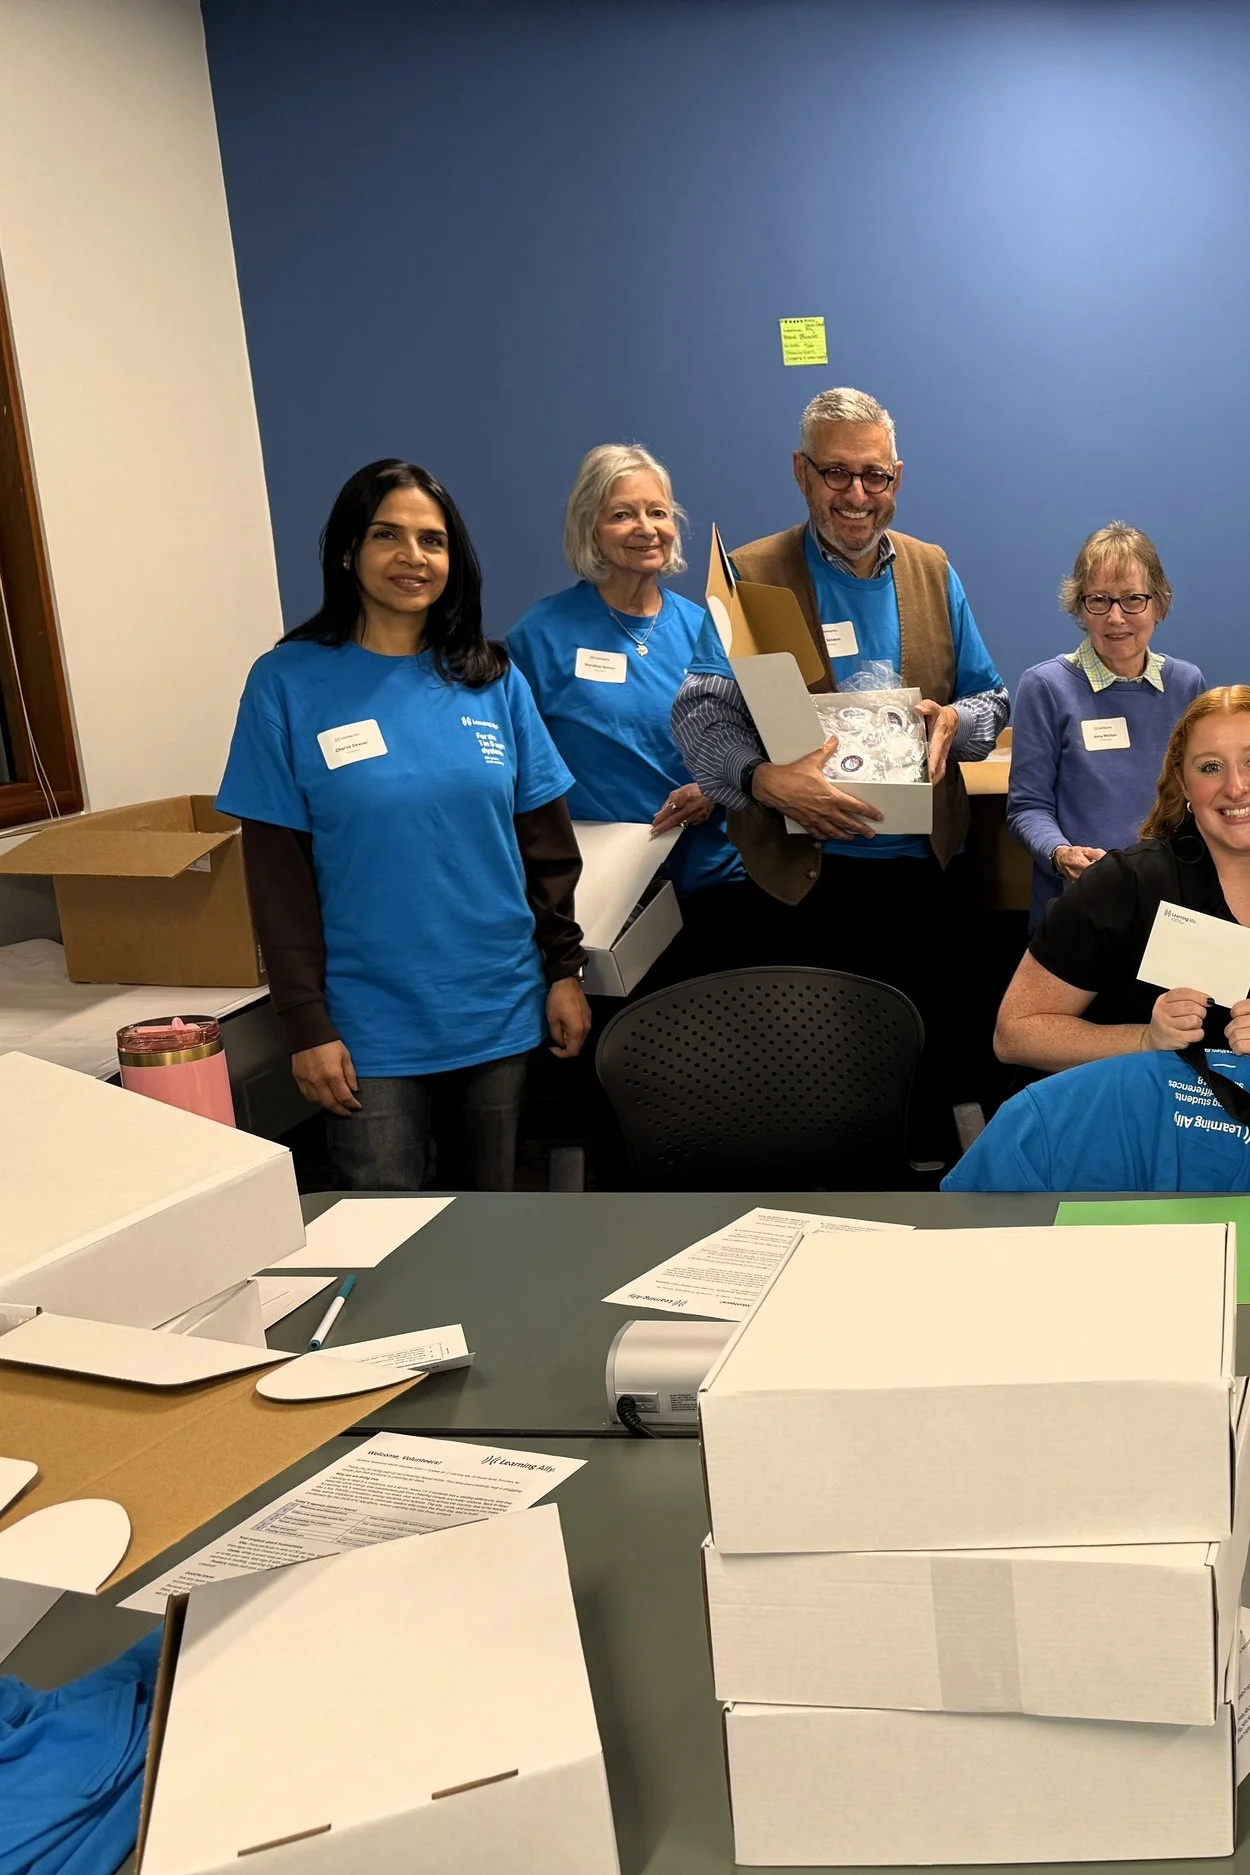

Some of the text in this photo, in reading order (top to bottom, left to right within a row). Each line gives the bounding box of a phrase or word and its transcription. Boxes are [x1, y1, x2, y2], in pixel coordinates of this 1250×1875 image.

[1175, 1092, 1211, 1106] students
[1194, 1115, 1242, 1137] Learning
[367, 1450, 443, 1465] Welcome, Volunteers!
[499, 1459, 538, 1470] Learning
